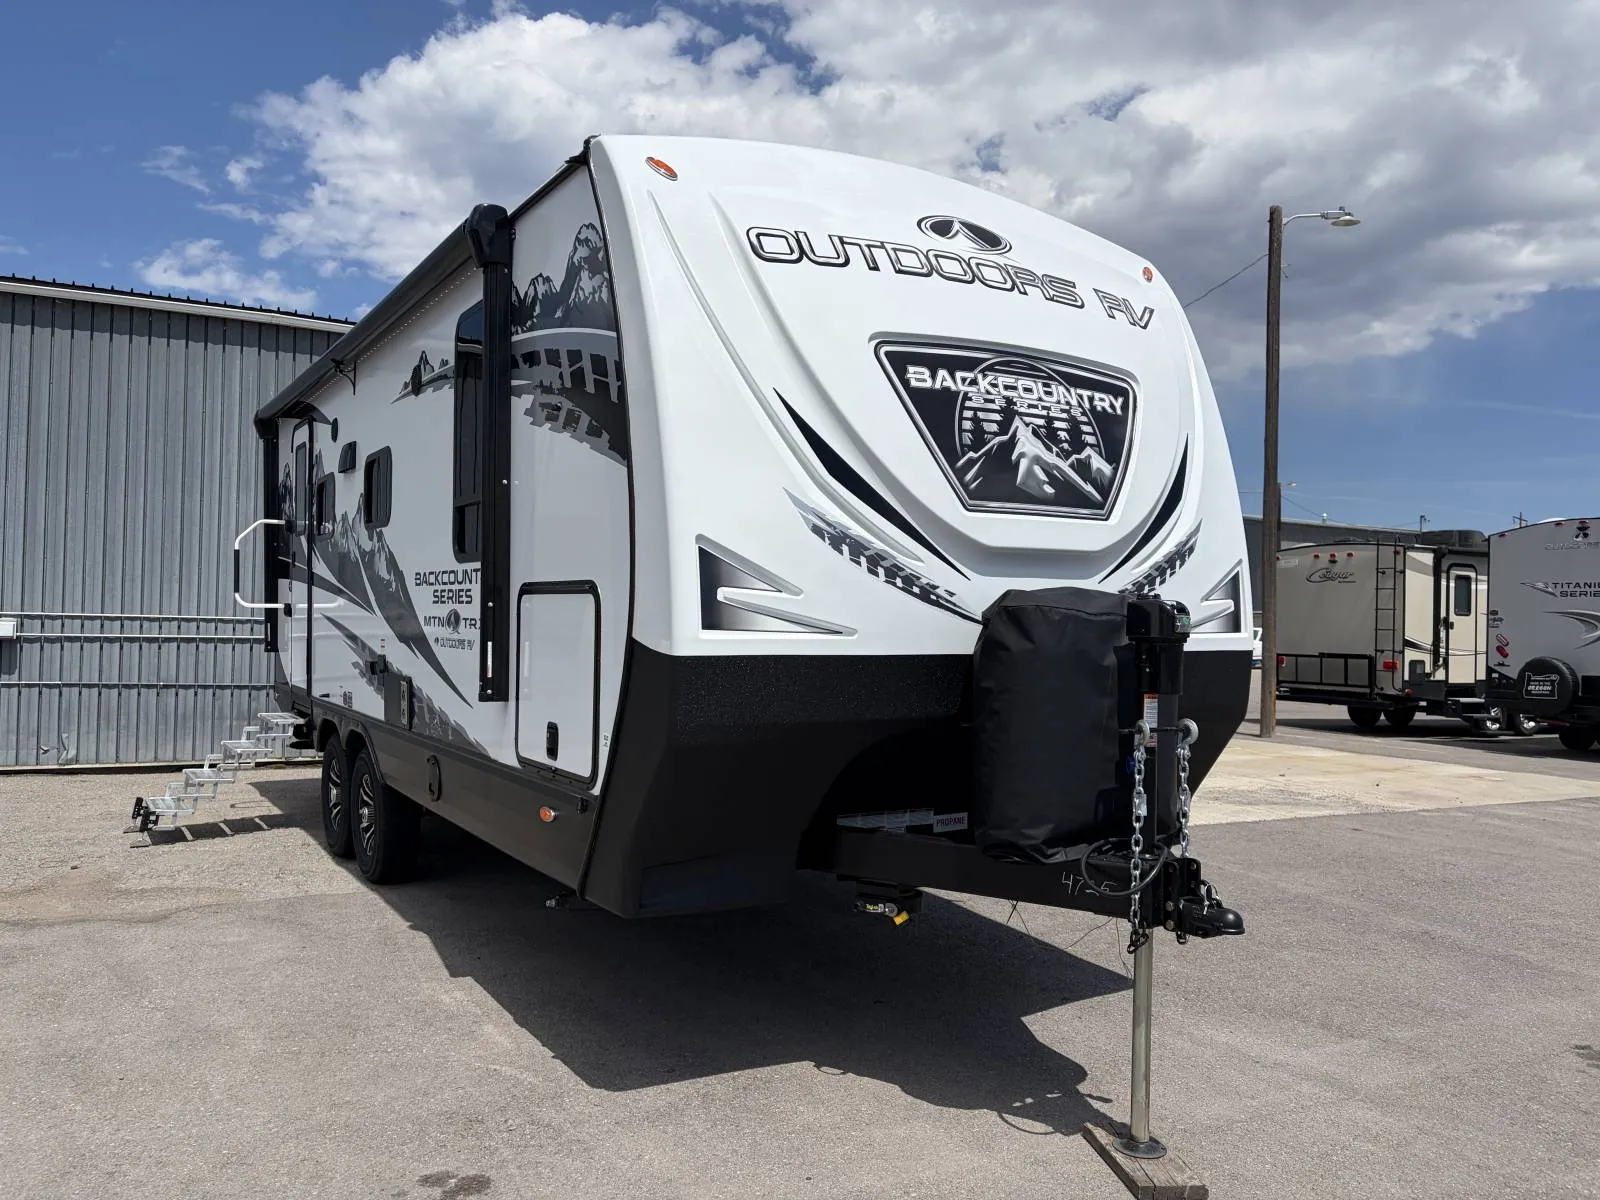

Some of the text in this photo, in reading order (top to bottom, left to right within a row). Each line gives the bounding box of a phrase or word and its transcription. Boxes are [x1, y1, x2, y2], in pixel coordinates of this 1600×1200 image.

[746, 226, 1155, 330] OUTDOORS RV
[905, 365, 1124, 416] BACKCOUNTRY
[971, 394, 1082, 418] SERIES
[414, 568, 480, 587] BACKCOUNT
[432, 588, 473, 605] SERIES
[423, 615, 480, 630] MTN TR
[936, 815, 966, 828] PROPANE
